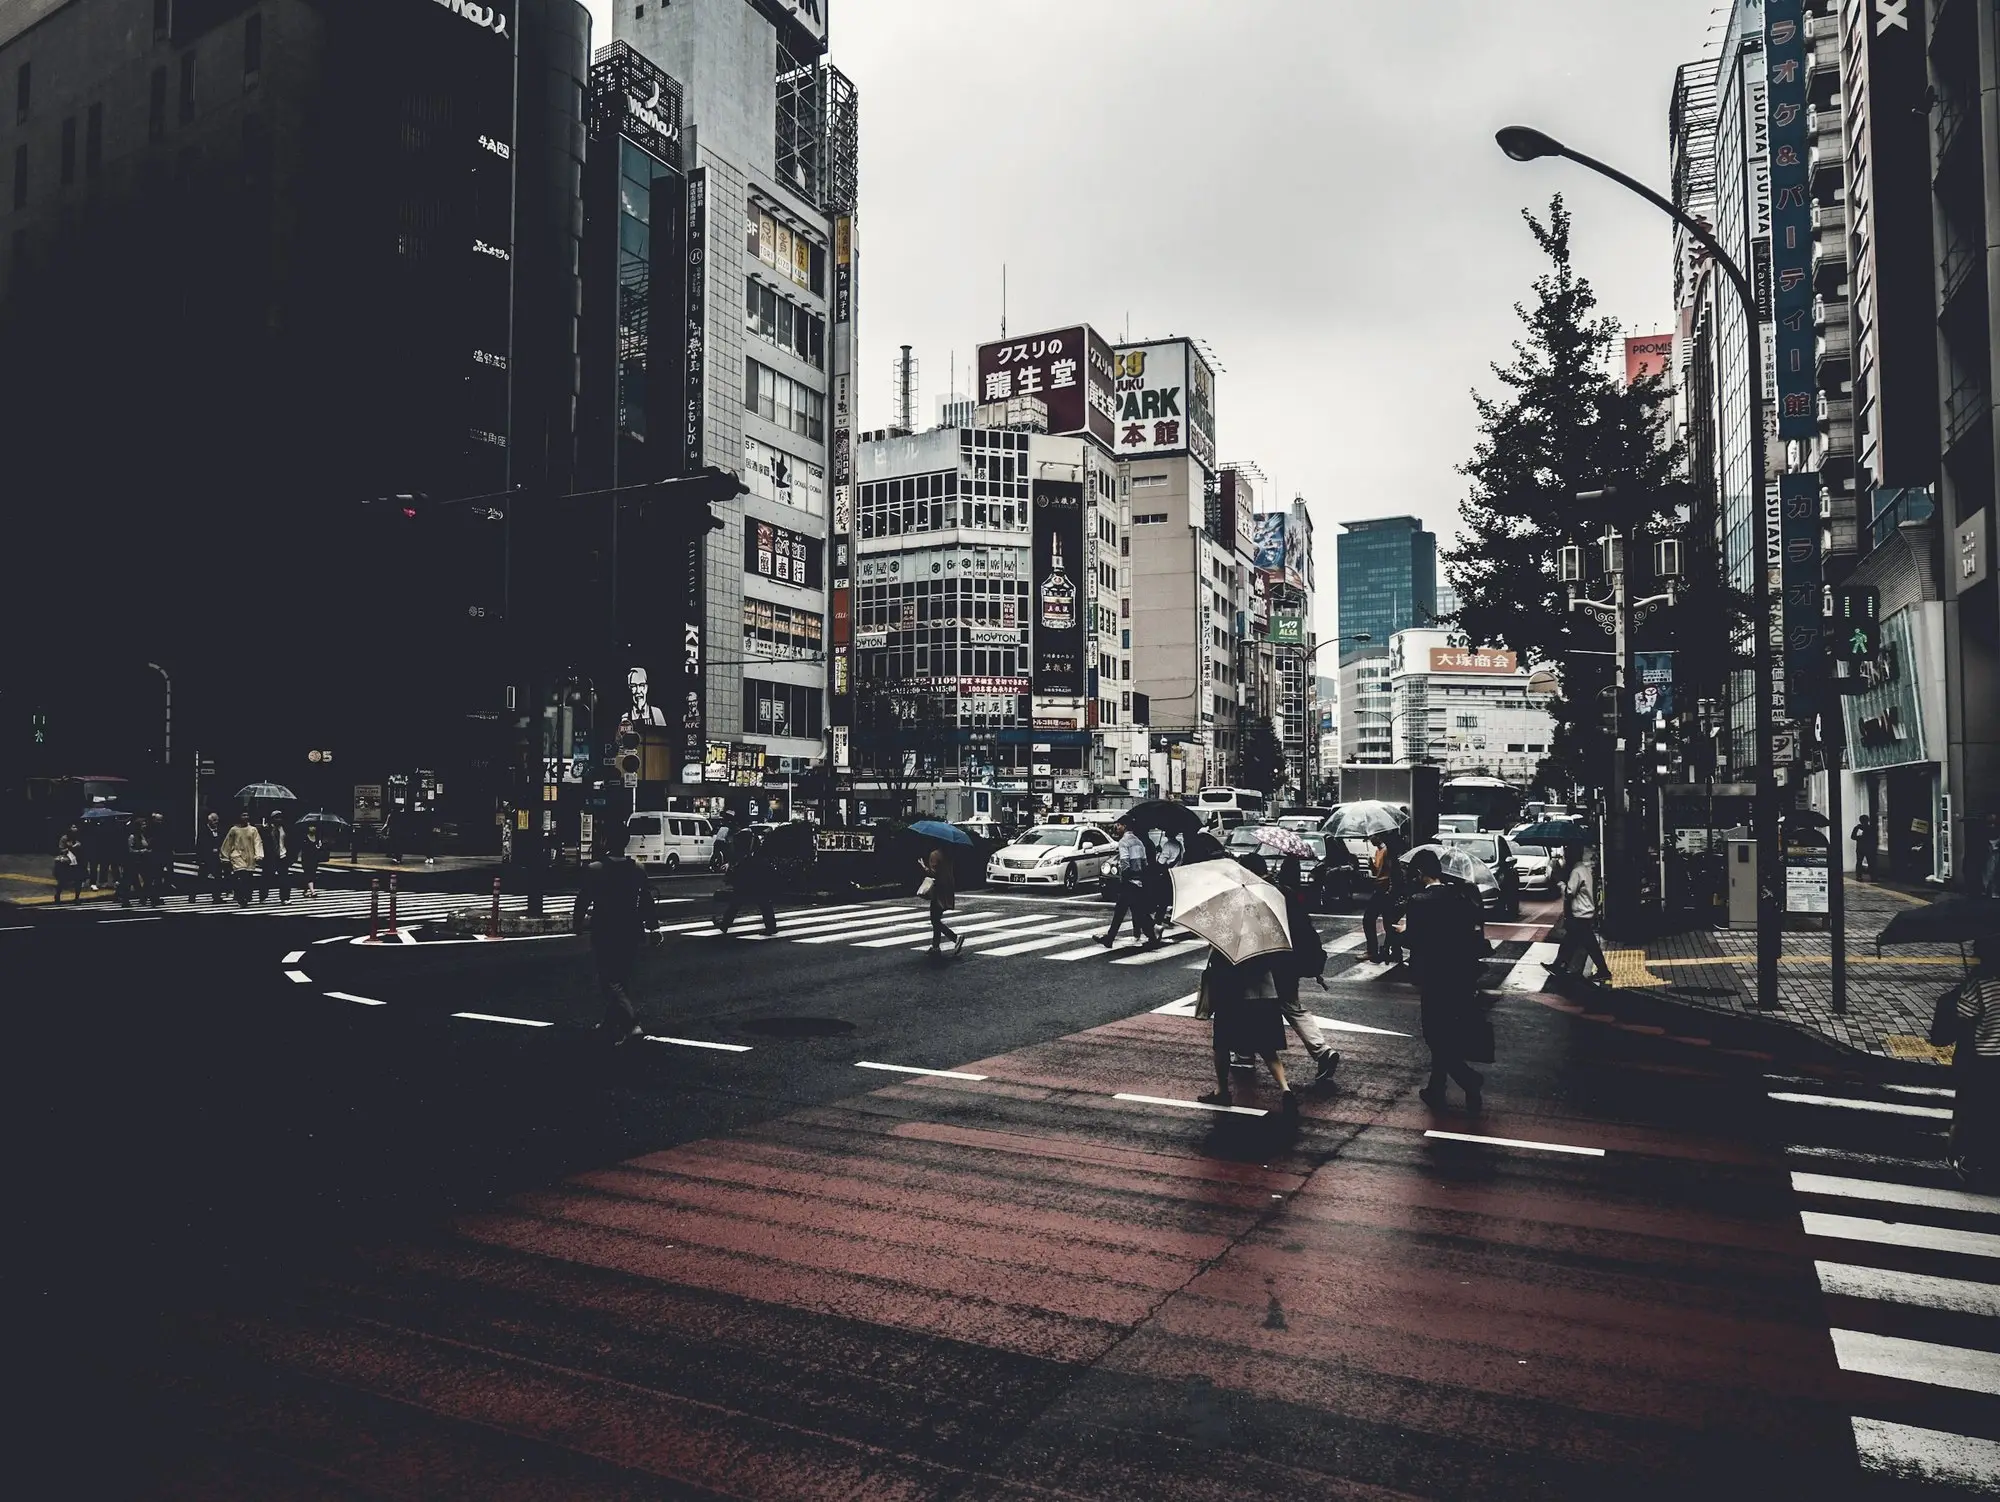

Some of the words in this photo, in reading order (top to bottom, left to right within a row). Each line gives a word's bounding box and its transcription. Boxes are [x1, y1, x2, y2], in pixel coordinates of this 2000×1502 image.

[1753, 86, 1767, 153] TSUTAYA
[1756, 164, 1770, 235] TSUTAYA
[1770, 0, 1812, 418] ラオケ&パーティー館
[1757, 262, 1766, 318] L'avenir
[997, 339, 1062, 367] クスリの
[1089, 346, 1113, 381] クスリの
[985, 358, 1076, 402] 龍生堂
[1088, 379, 1114, 422] 龍生堂
[688, 399, 697, 445] ともしび
[1121, 420, 1179, 448] 本館
[1765, 489, 1780, 562] TSUTAYA
[946, 560, 956, 570] 6F
[837, 580, 846, 588] 2F
[1279, 620, 1298, 629] レイク
[1279, 628, 1298, 637] ALSA
[685, 622, 699, 676] KFC
[1437, 653, 1510, 668] 大塚商会
[760, 698, 785, 723] 和民
[961, 701, 1000, 713] 木村屋
